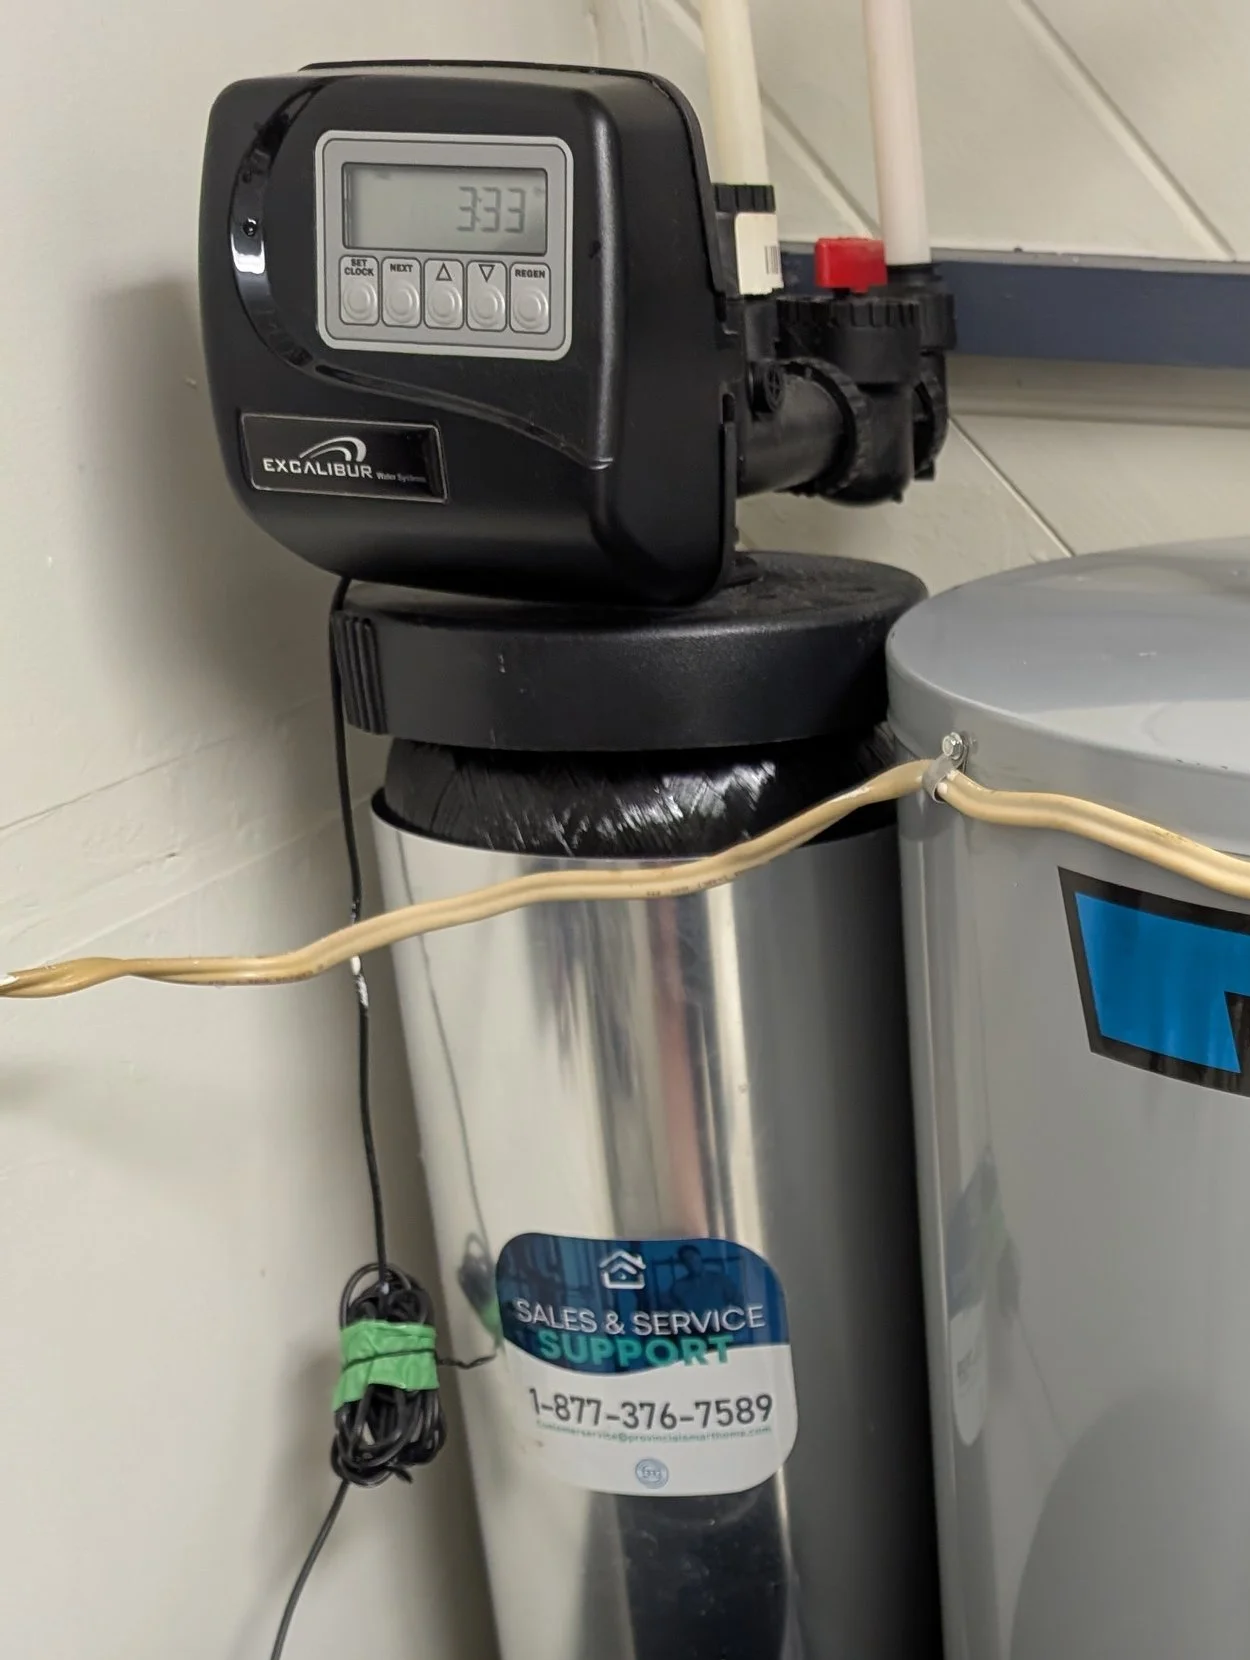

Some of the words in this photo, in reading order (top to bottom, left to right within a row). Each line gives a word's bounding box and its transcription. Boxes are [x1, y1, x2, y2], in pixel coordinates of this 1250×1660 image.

[351, 259, 367, 267] SET
[390, 263, 413, 273] NEXT
[344, 267, 374, 276] CLOCK
[515, 270, 545, 278] REGEN
[263, 457, 373, 479] EXCALIBUR
[514, 1299, 597, 1333] SALES
[604, 1311, 625, 1334] &
[632, 1303, 766, 1336] SERVICE
[537, 1329, 734, 1367] SUPPORT
[529, 1387, 773, 1430] 1-877-376-7589
